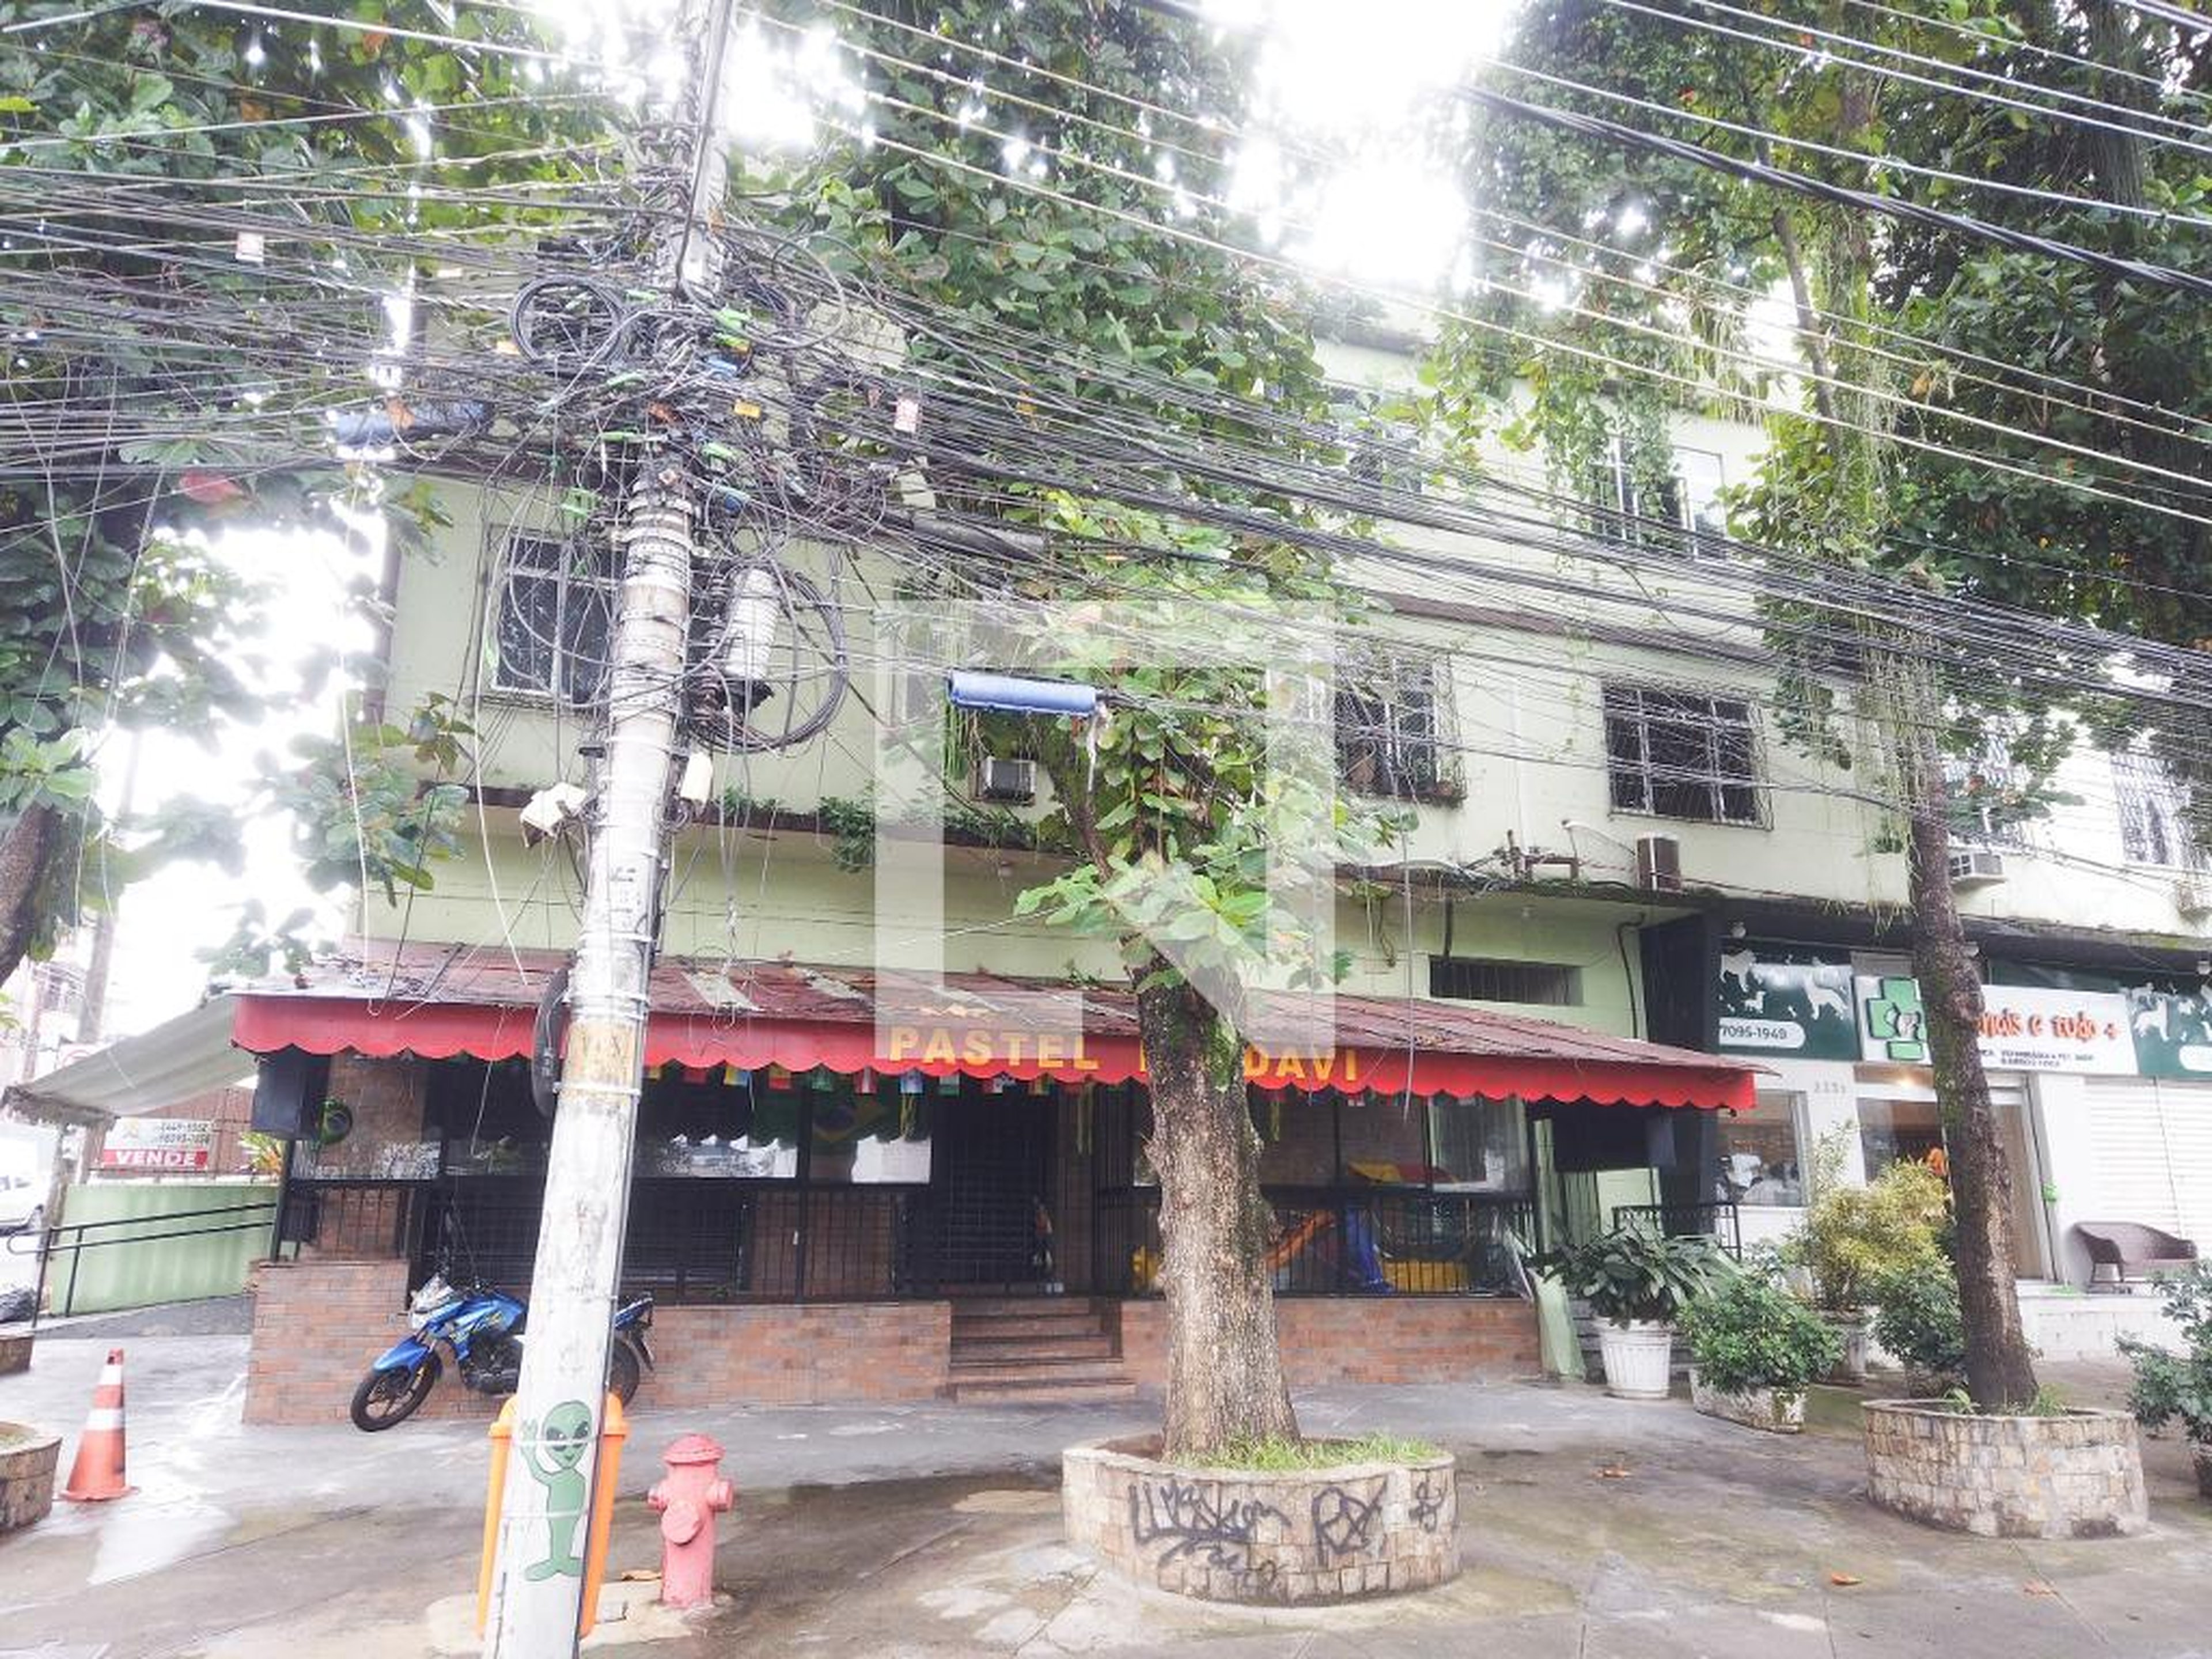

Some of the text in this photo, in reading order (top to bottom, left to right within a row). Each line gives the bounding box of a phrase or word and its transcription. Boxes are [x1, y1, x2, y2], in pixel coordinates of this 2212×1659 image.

[889, 1027, 1100, 1070] PASTEL
[1244, 1043, 1357, 1081] DAVI
[115, 1150, 196, 1166] VENDE
